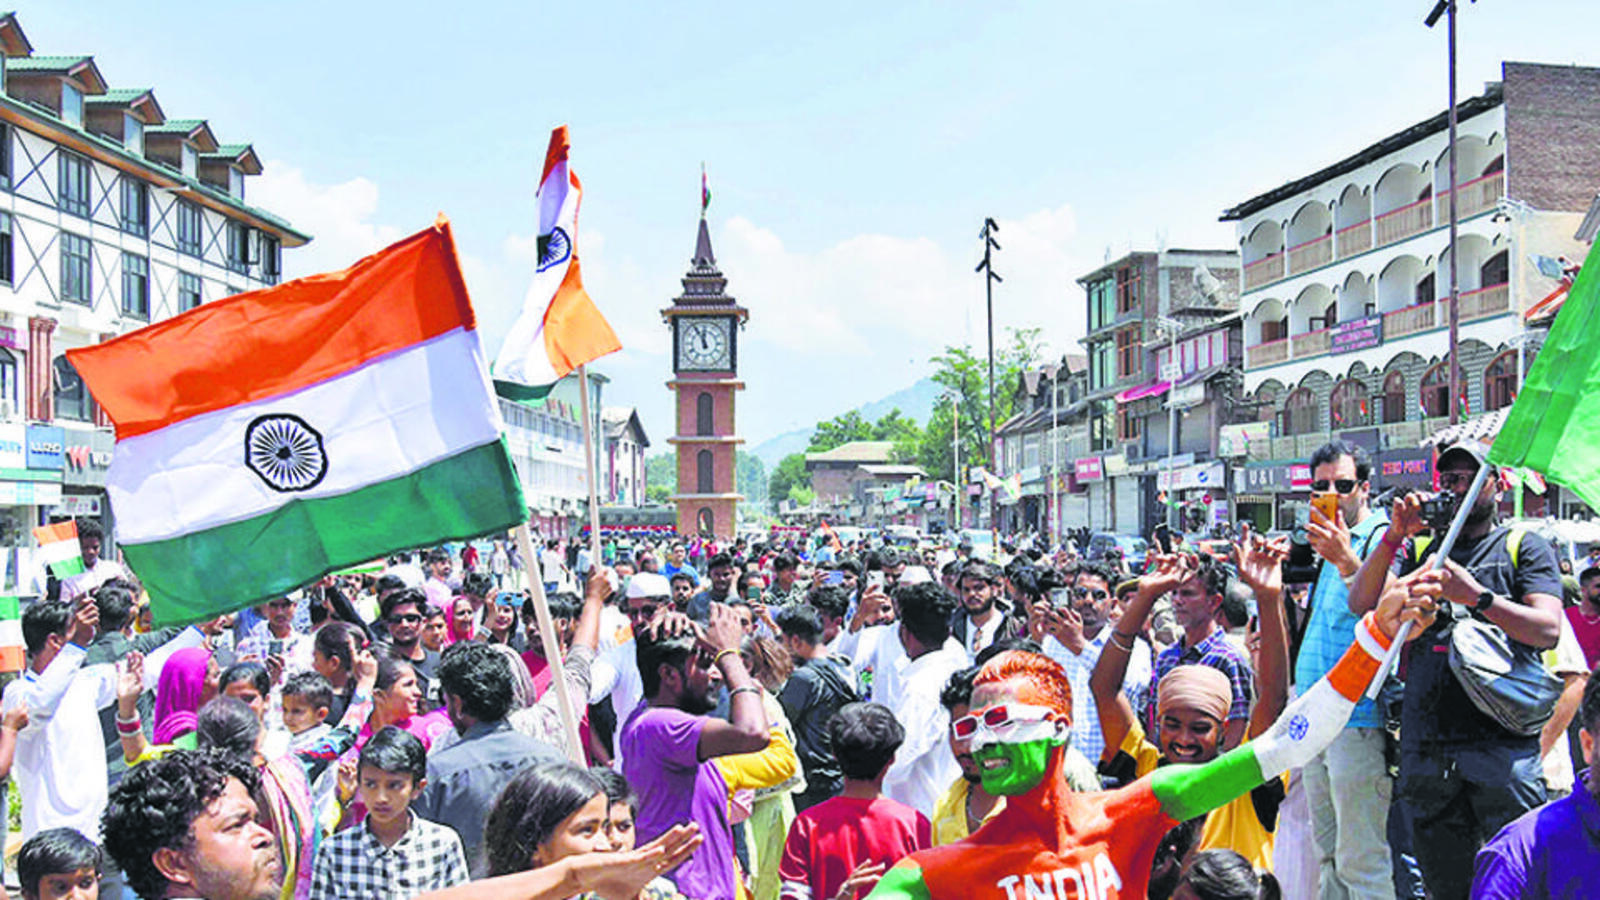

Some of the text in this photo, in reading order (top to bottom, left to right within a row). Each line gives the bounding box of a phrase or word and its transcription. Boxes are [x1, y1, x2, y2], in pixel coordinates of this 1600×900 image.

[1383, 460, 1426, 475] ZERO POINT
[996, 852, 1123, 900] INDIA
